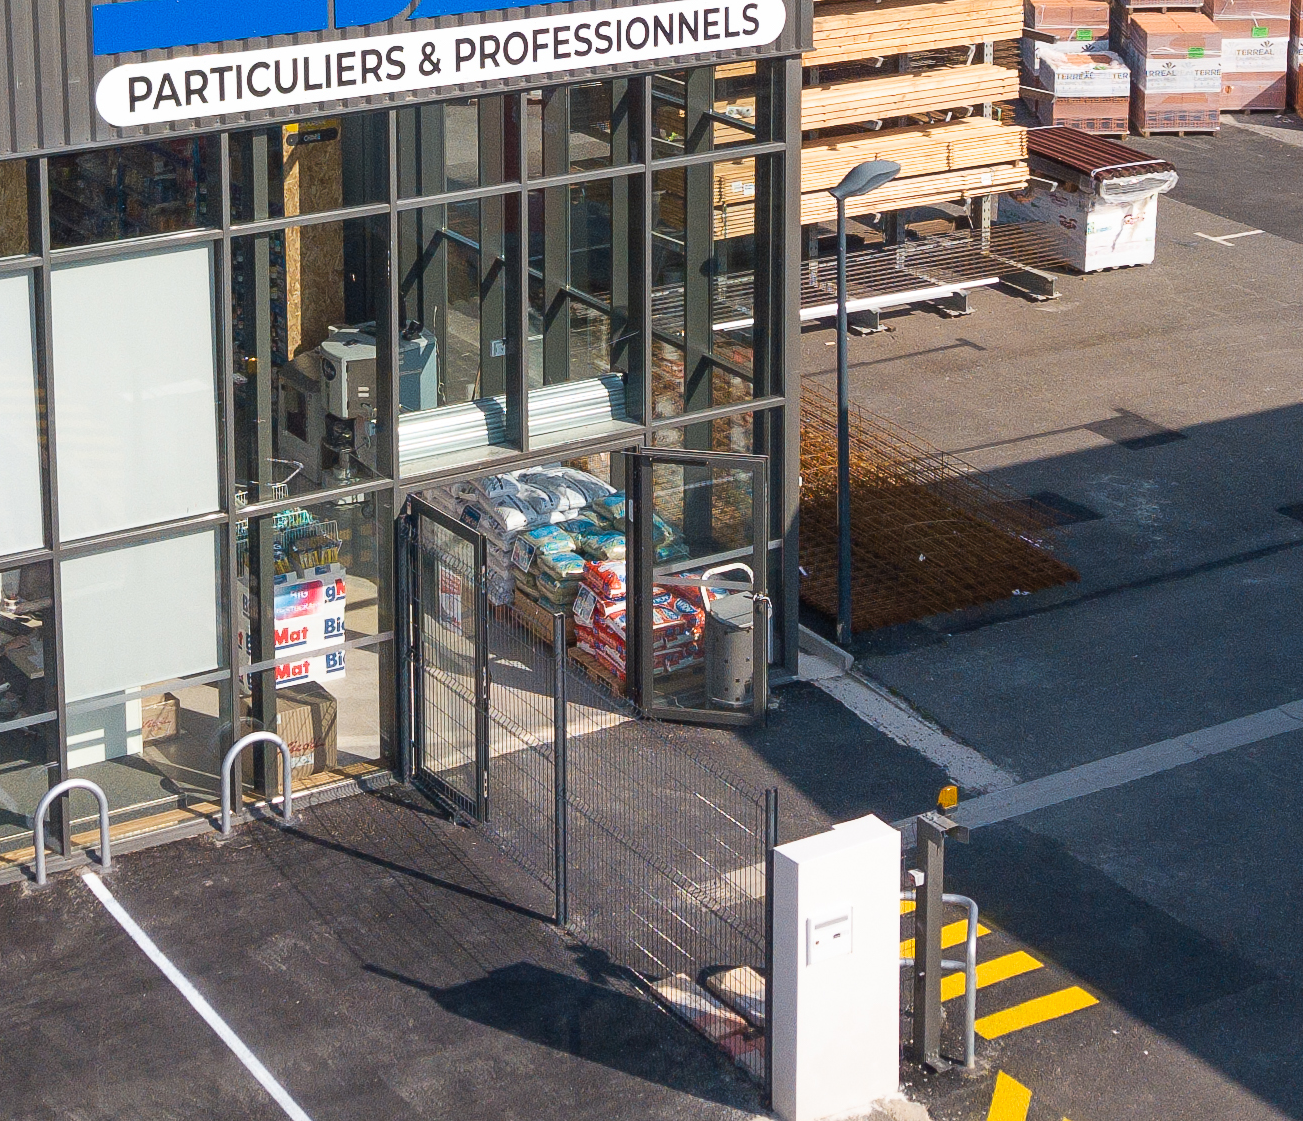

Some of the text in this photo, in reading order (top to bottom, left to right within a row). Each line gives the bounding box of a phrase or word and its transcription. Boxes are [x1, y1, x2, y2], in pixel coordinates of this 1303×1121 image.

[128, 3, 760, 113] PARTICULIERS & PROFESSIONNELS
[1236, 48, 1275, 56] TERREAL
